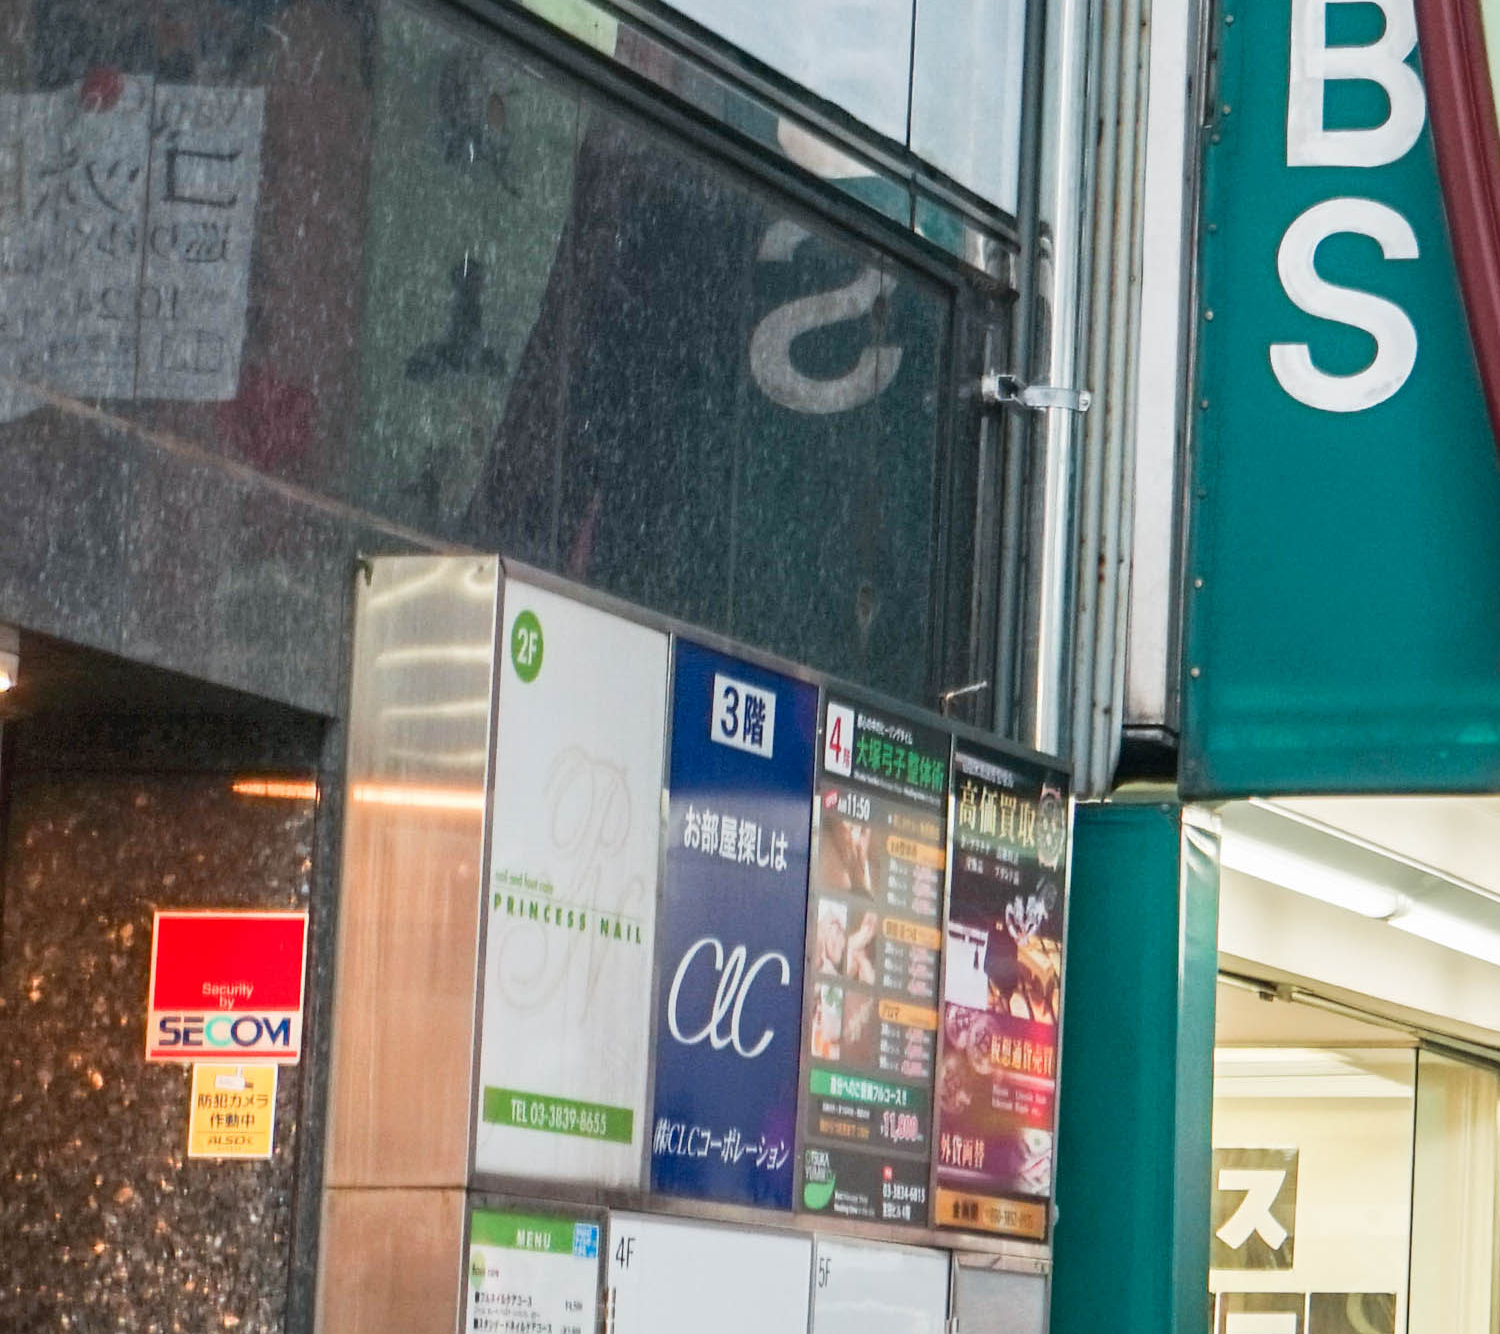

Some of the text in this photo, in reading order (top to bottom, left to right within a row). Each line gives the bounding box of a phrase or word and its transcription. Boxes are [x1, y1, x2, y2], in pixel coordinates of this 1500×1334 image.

[517, 628, 539, 665] 2F
[720, 686, 767, 748] 3階
[958, 778, 1037, 849] 高価買取
[684, 804, 789, 872] お部屋探しは
[494, 892, 642, 945] PRINCESS NAIL
[202, 982, 254, 998] Security
[219, 996, 235, 1010] by
[159, 1016, 291, 1047] SECOM
[197, 1093, 269, 1108] 防犯カメラ
[511, 1099, 528, 1121] TEL
[210, 1113, 255, 1129] 作動中
[1215, 1169, 1290, 1251] ス
[516, 1227, 552, 1250] MENU
[616, 1235, 636, 1270] 4F
[818, 1257, 832, 1290] 5F
